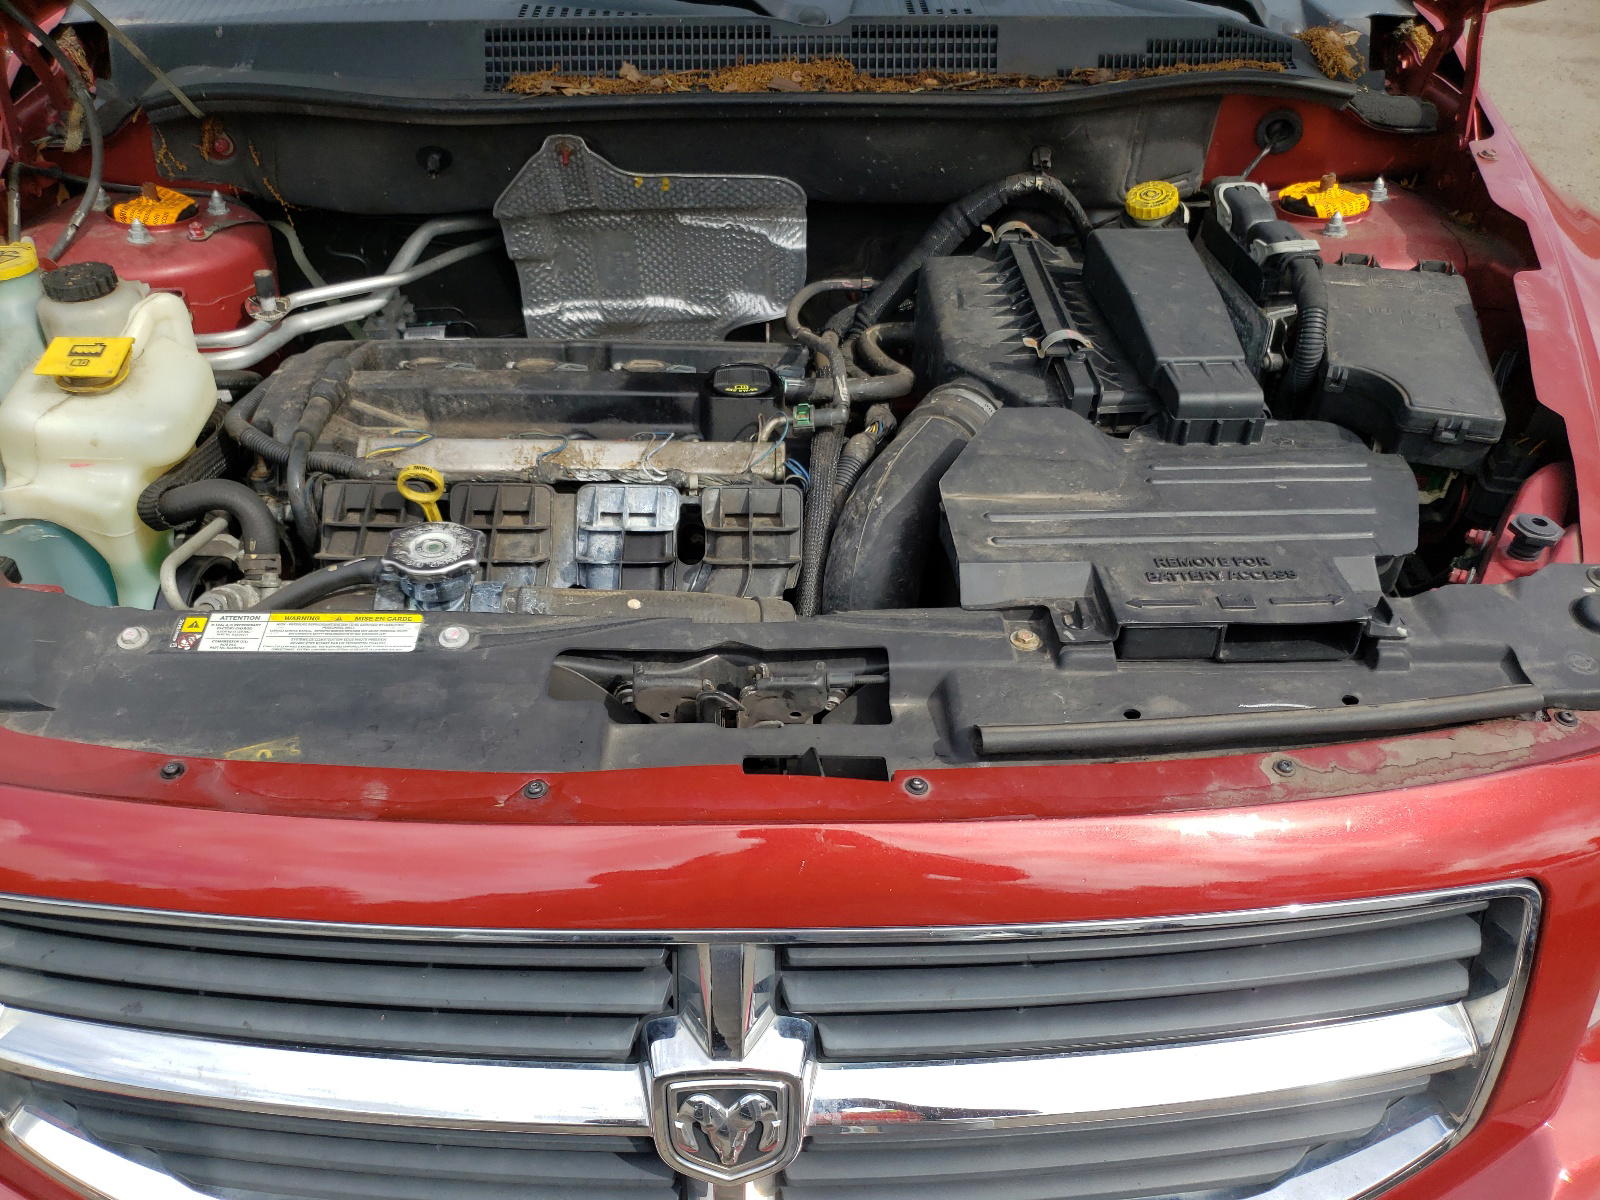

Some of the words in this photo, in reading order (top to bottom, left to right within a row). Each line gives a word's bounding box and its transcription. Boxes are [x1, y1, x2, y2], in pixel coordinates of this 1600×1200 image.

[1153, 556, 1230, 569] REMOVE
[1231, 556, 1272, 568] FOR
[1144, 570, 1221, 583] BATTERY
[1227, 569, 1298, 582] ACCESS
